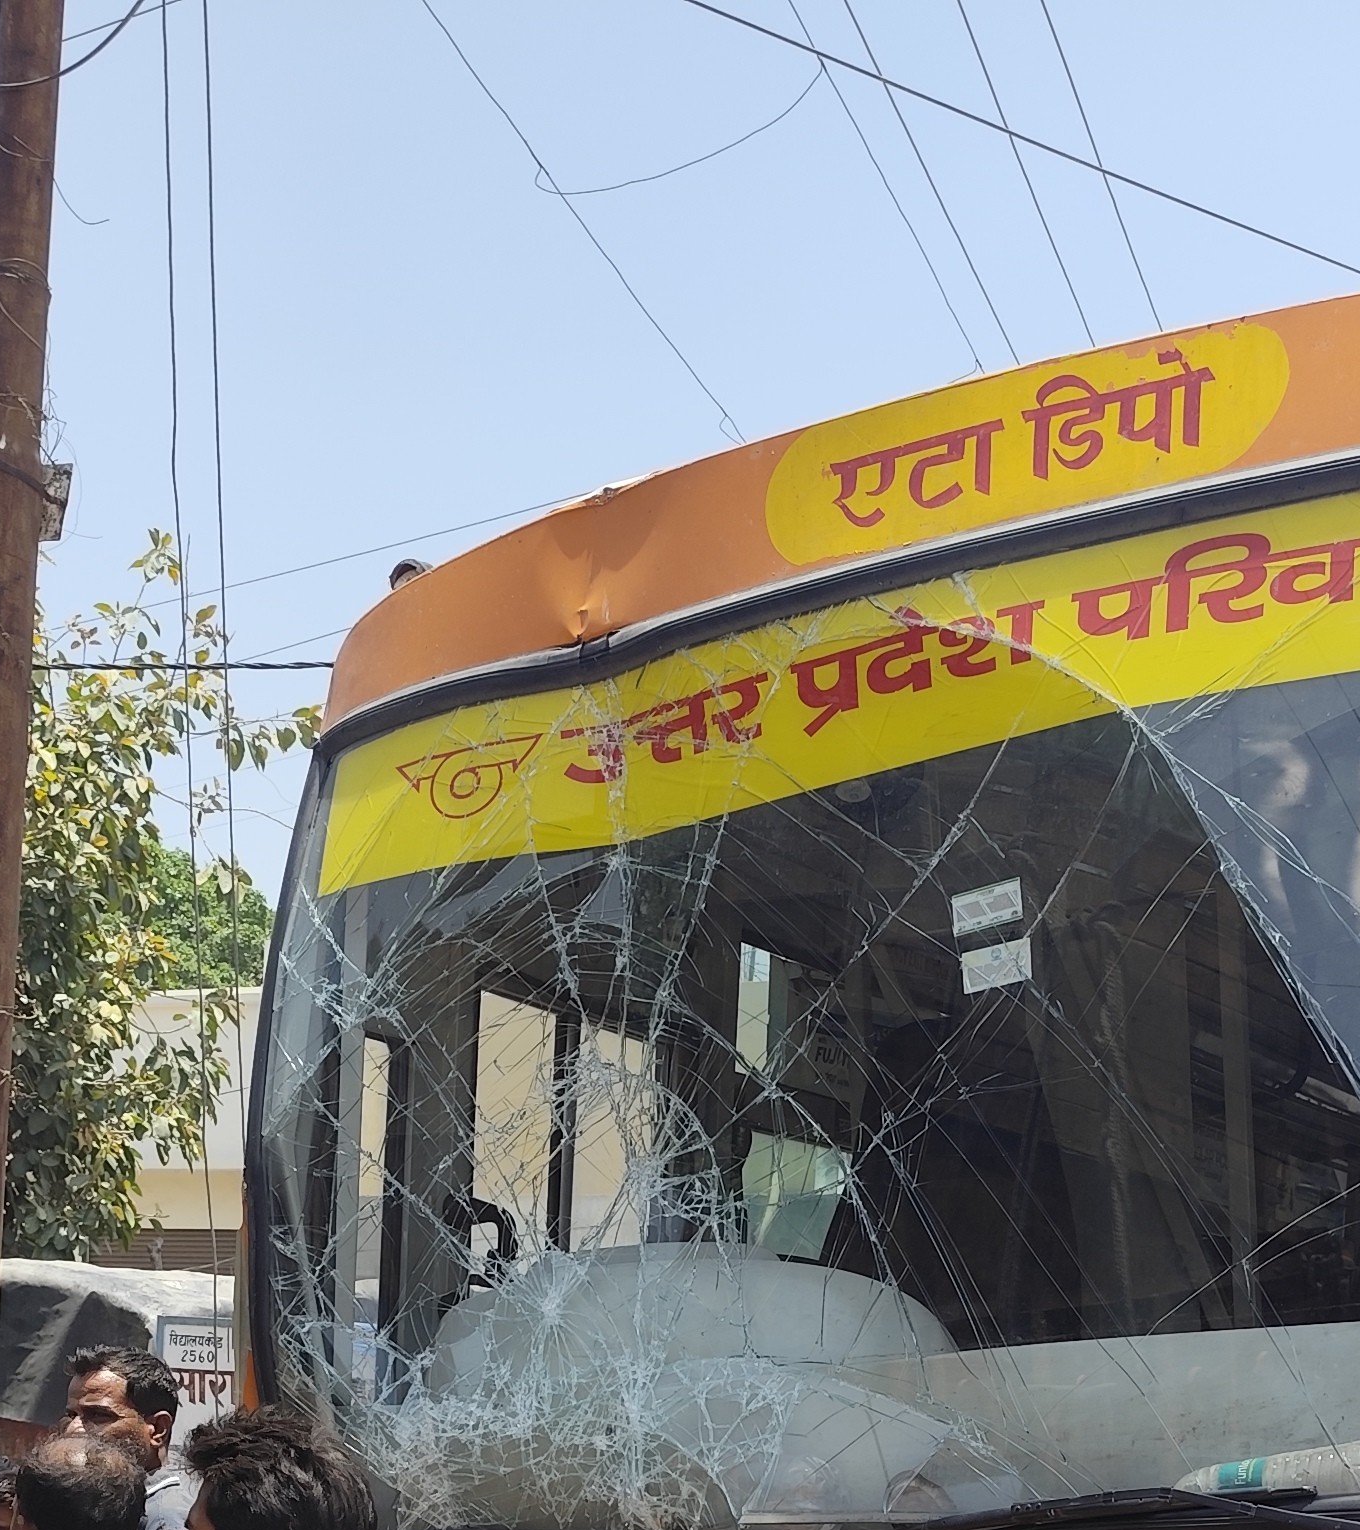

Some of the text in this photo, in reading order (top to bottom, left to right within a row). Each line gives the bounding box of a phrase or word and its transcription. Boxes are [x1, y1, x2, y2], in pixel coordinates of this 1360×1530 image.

[830, 348, 1215, 527] एटा डिपो
[561, 672, 770, 785] उत्तर
[791, 598, 1044, 735] प्रदेश
